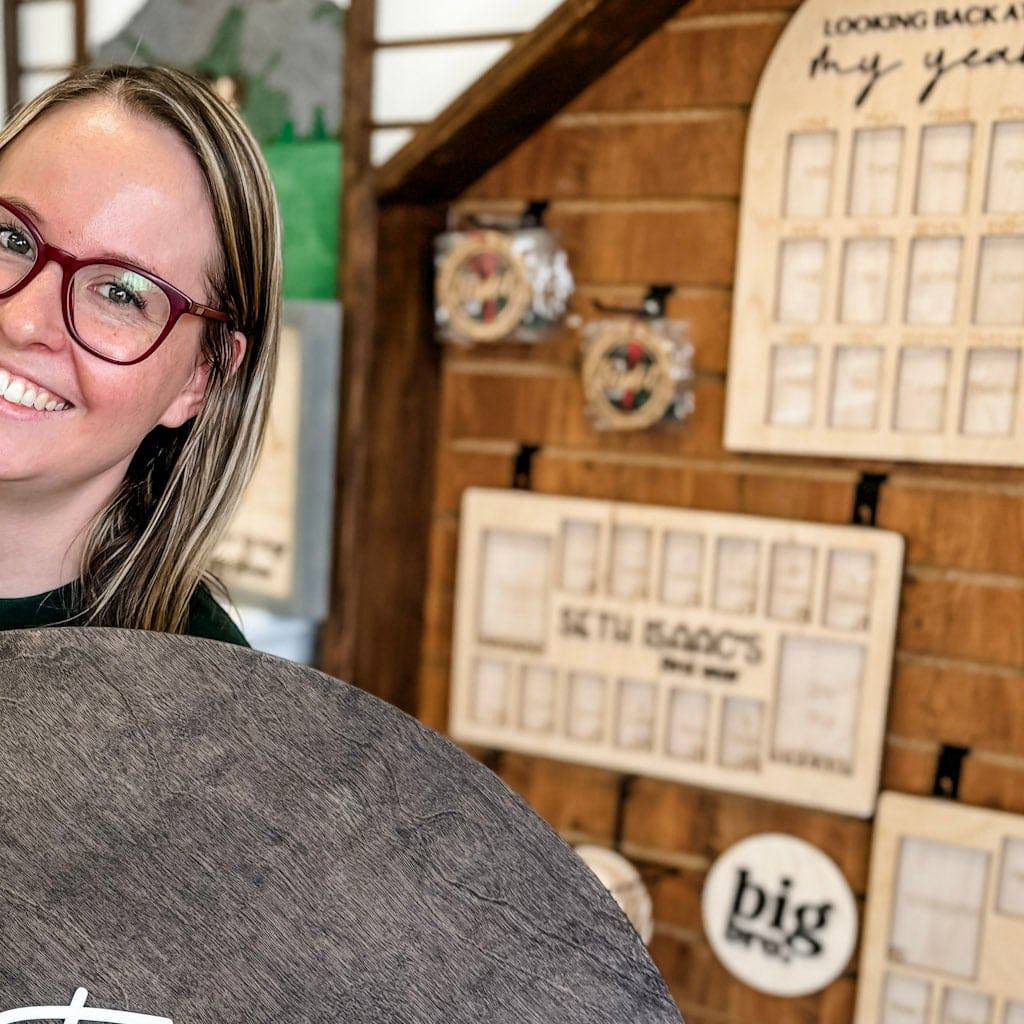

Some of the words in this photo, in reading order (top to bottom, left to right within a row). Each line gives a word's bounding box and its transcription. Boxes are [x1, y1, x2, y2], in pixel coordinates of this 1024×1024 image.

[824, 10, 927, 37] LOOKING
[934, 5, 998, 28] BACK
[1003, 2, 1024, 22] A
[809, 44, 903, 109] my
[733, 868, 834, 957] big
